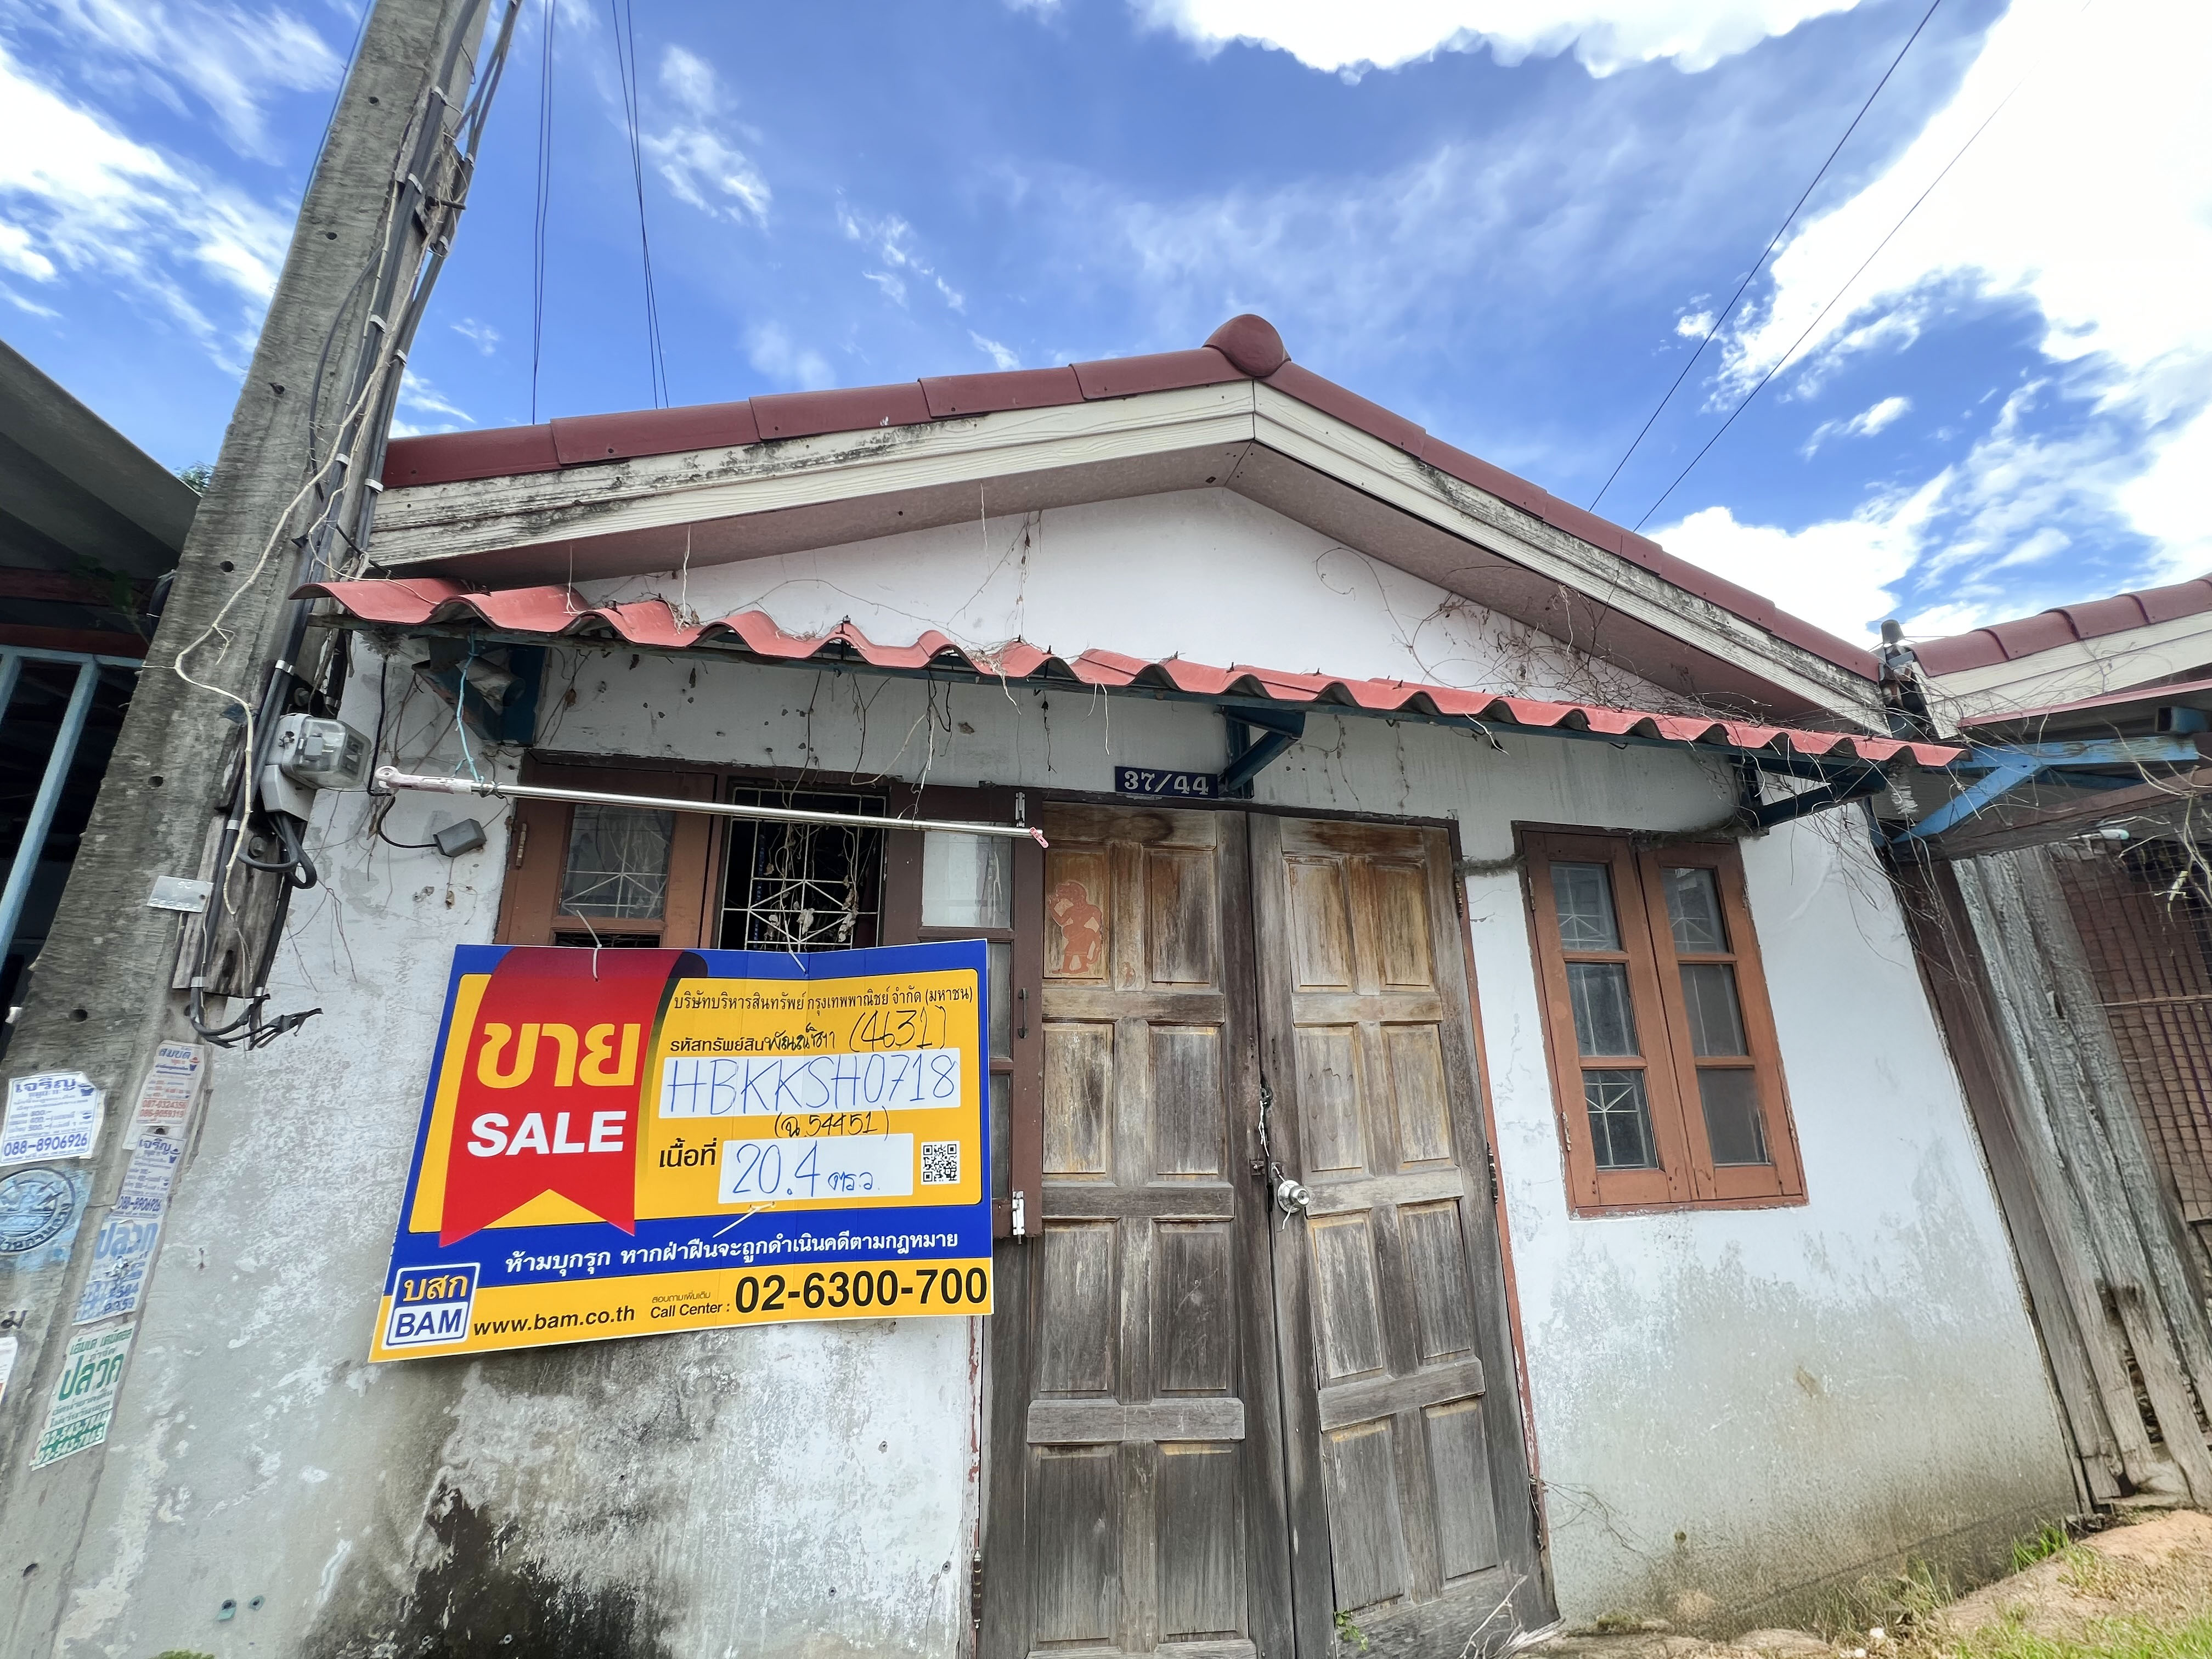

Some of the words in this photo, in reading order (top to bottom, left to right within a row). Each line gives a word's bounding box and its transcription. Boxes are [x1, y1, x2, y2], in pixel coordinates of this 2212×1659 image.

[1124, 770, 1209, 795] 37/44
[892, 985, 922, 1005] จำกัด
[925, 986, 973, 1006] (มหาชน)
[477, 1022, 641, 1089] ขาย
[670, 1036, 764, 1052] รหัสทรัพย์สิน
[15, 1077, 76, 1093] เจริญ
[667, 1053, 961, 1115] HBKKSH0718
[3, 1132, 88, 1156] 088-8906926
[138, 1138, 172, 1155] เจริญ
[467, 1110, 627, 1157] SALE
[659, 1138, 716, 1169] เนื้อที่
[732, 1140, 821, 1197] 20.4
[505, 1249, 611, 1278] ห้ามบุกรุก
[403, 1274, 468, 1302] บสก
[650, 1304, 676, 1319] Call
[679, 1302, 723, 1316] Center
[734, 1266, 988, 1314] 02-6300-700
[394, 1308, 462, 1339] BAM
[473, 1304, 635, 1336] www.bam.co.th
[58, 1353, 125, 1401] ปลวก
